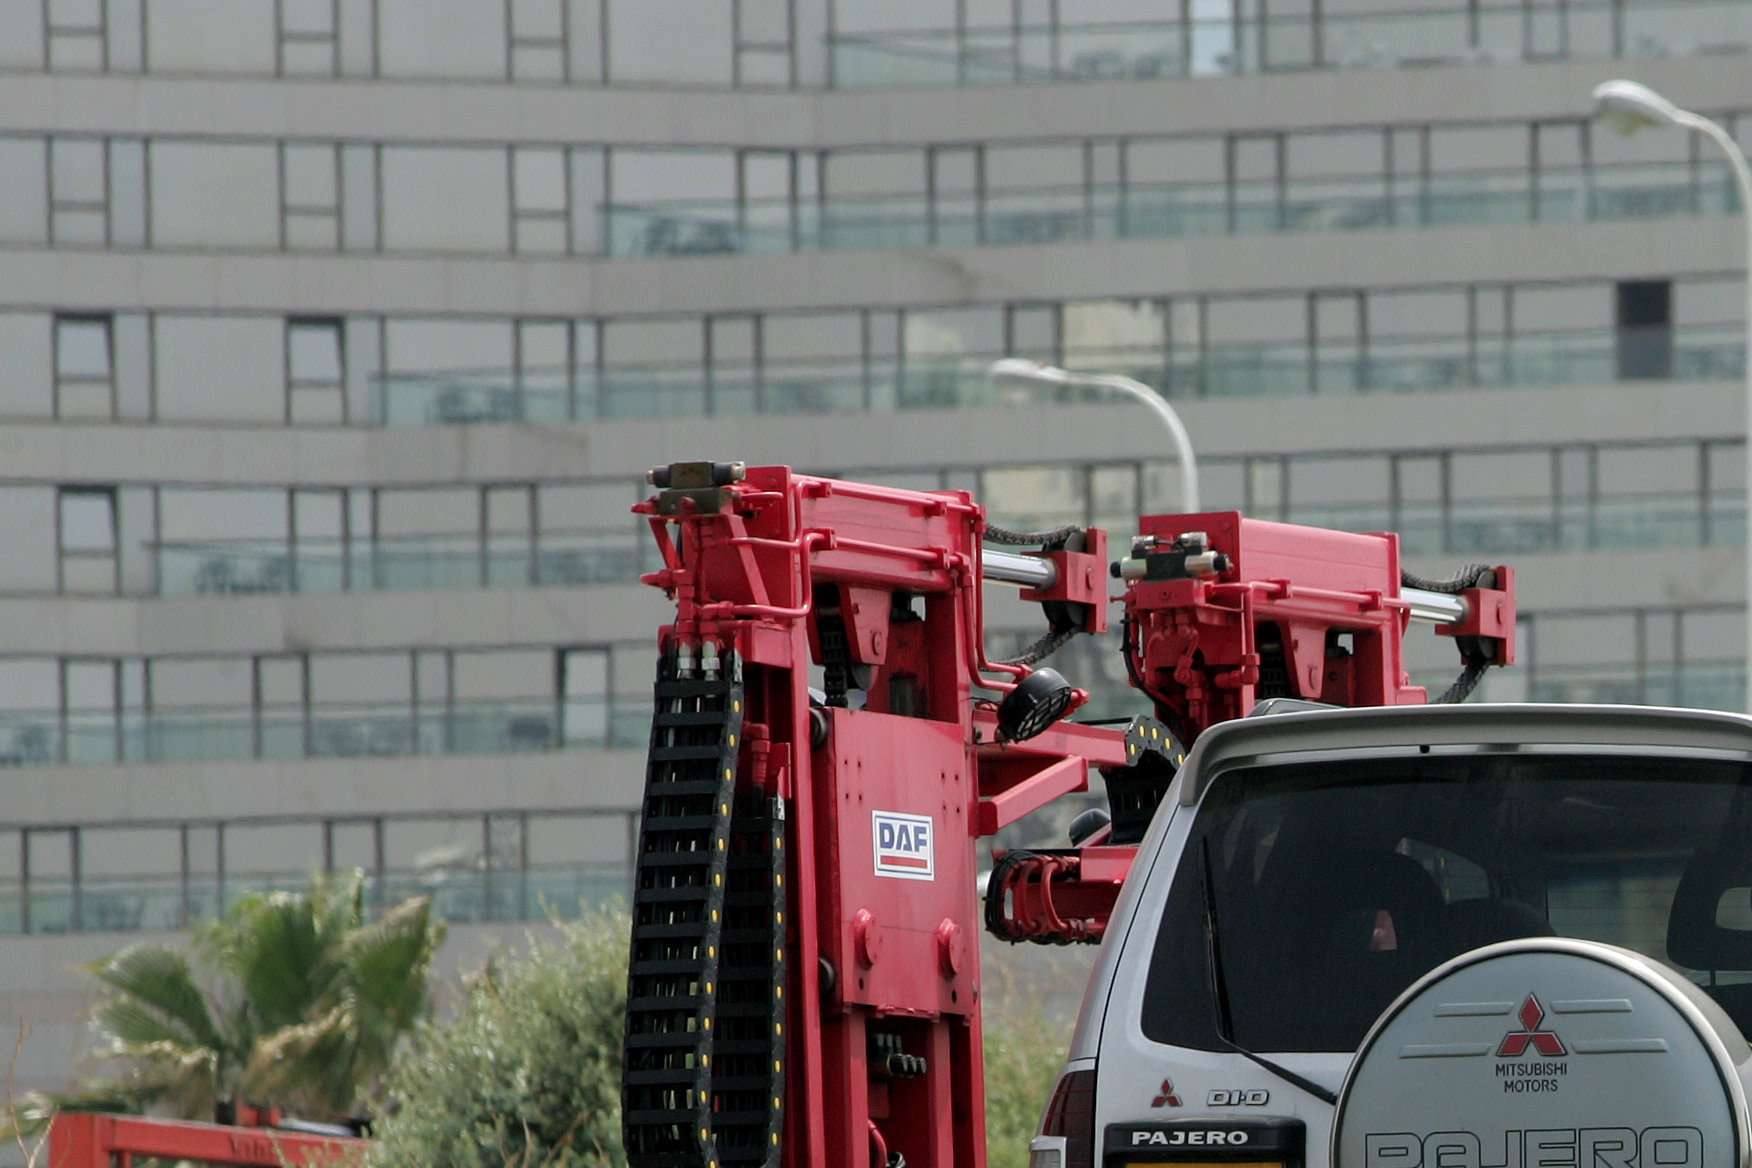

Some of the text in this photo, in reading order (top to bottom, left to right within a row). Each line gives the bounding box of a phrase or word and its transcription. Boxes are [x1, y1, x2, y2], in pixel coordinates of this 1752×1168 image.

[879, 822, 927, 852] DAF
[1495, 1063, 1567, 1077] MITSUBISHI
[1504, 1079, 1558, 1093] MOTORS
[1131, 1131, 1249, 1146] PAJERO
